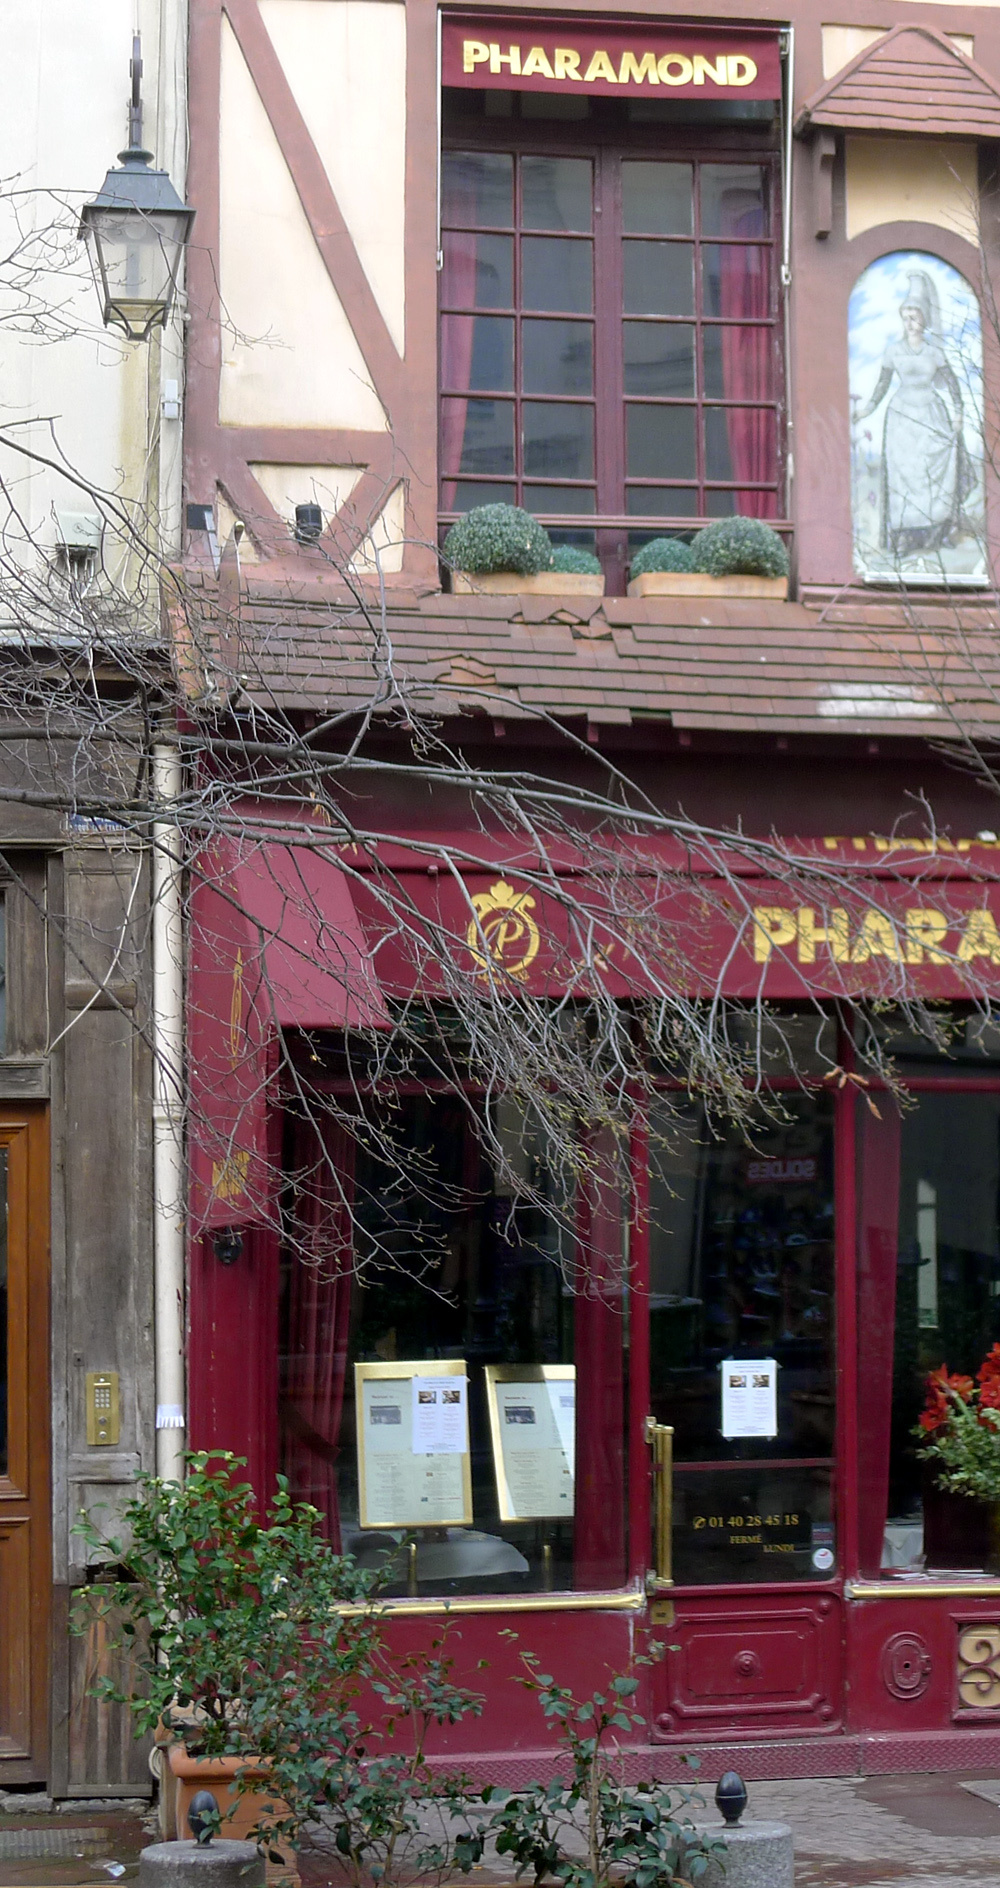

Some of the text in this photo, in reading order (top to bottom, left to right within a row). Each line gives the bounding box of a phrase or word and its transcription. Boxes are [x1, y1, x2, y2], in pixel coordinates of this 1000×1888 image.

[462, 40, 758, 86] PHARAMOND
[708, 1516, 724, 1528] 01
[727, 1515, 745, 1527] 40
[765, 1514, 780, 1526] 45
[785, 1514, 799, 1526] 18
